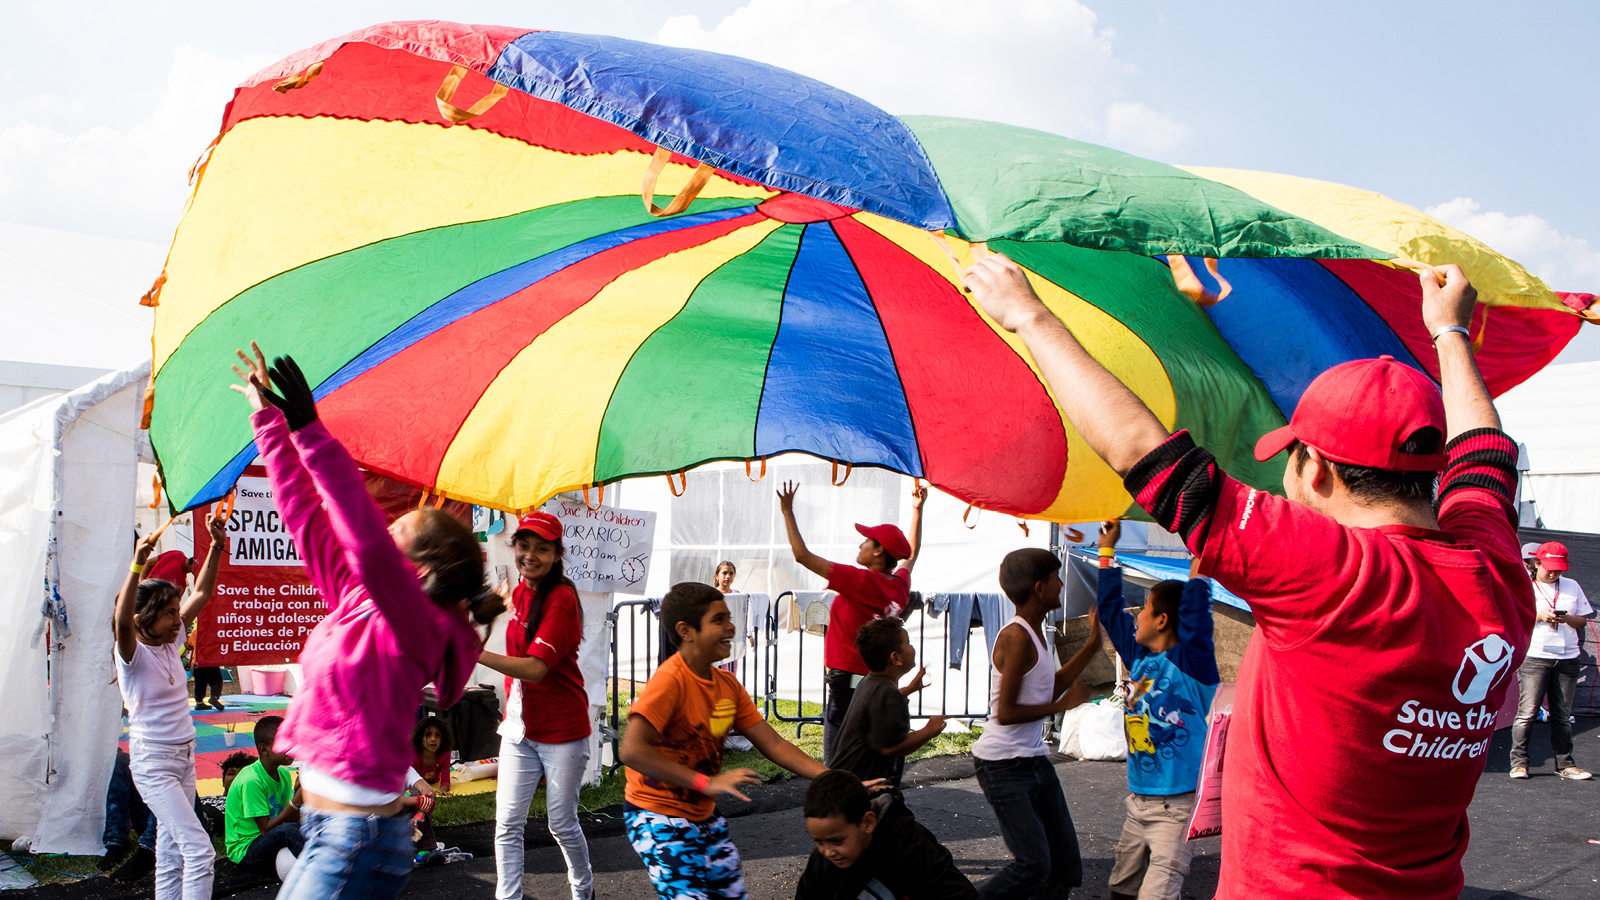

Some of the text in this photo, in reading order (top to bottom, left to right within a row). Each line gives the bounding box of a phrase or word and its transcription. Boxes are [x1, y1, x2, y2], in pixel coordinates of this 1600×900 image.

[241, 489, 276, 499] Save th
[222, 508, 286, 533] SPACI
[557, 501, 581, 519] Save
[604, 510, 646, 528] Children
[1239, 499, 1255, 530] Children
[235, 537, 303, 561] AMIGA
[217, 584, 250, 596] Save
[253, 584, 276, 596] the
[233, 598, 284, 613] trabaja
[287, 600, 310, 610] con
[217, 612, 329, 626] niños y adolesce
[217, 625, 314, 638] acciones de Pr
[220, 640, 301, 655] y Educación
[1397, 700, 1499, 731] Save the
[1382, 728, 1489, 760] Children
